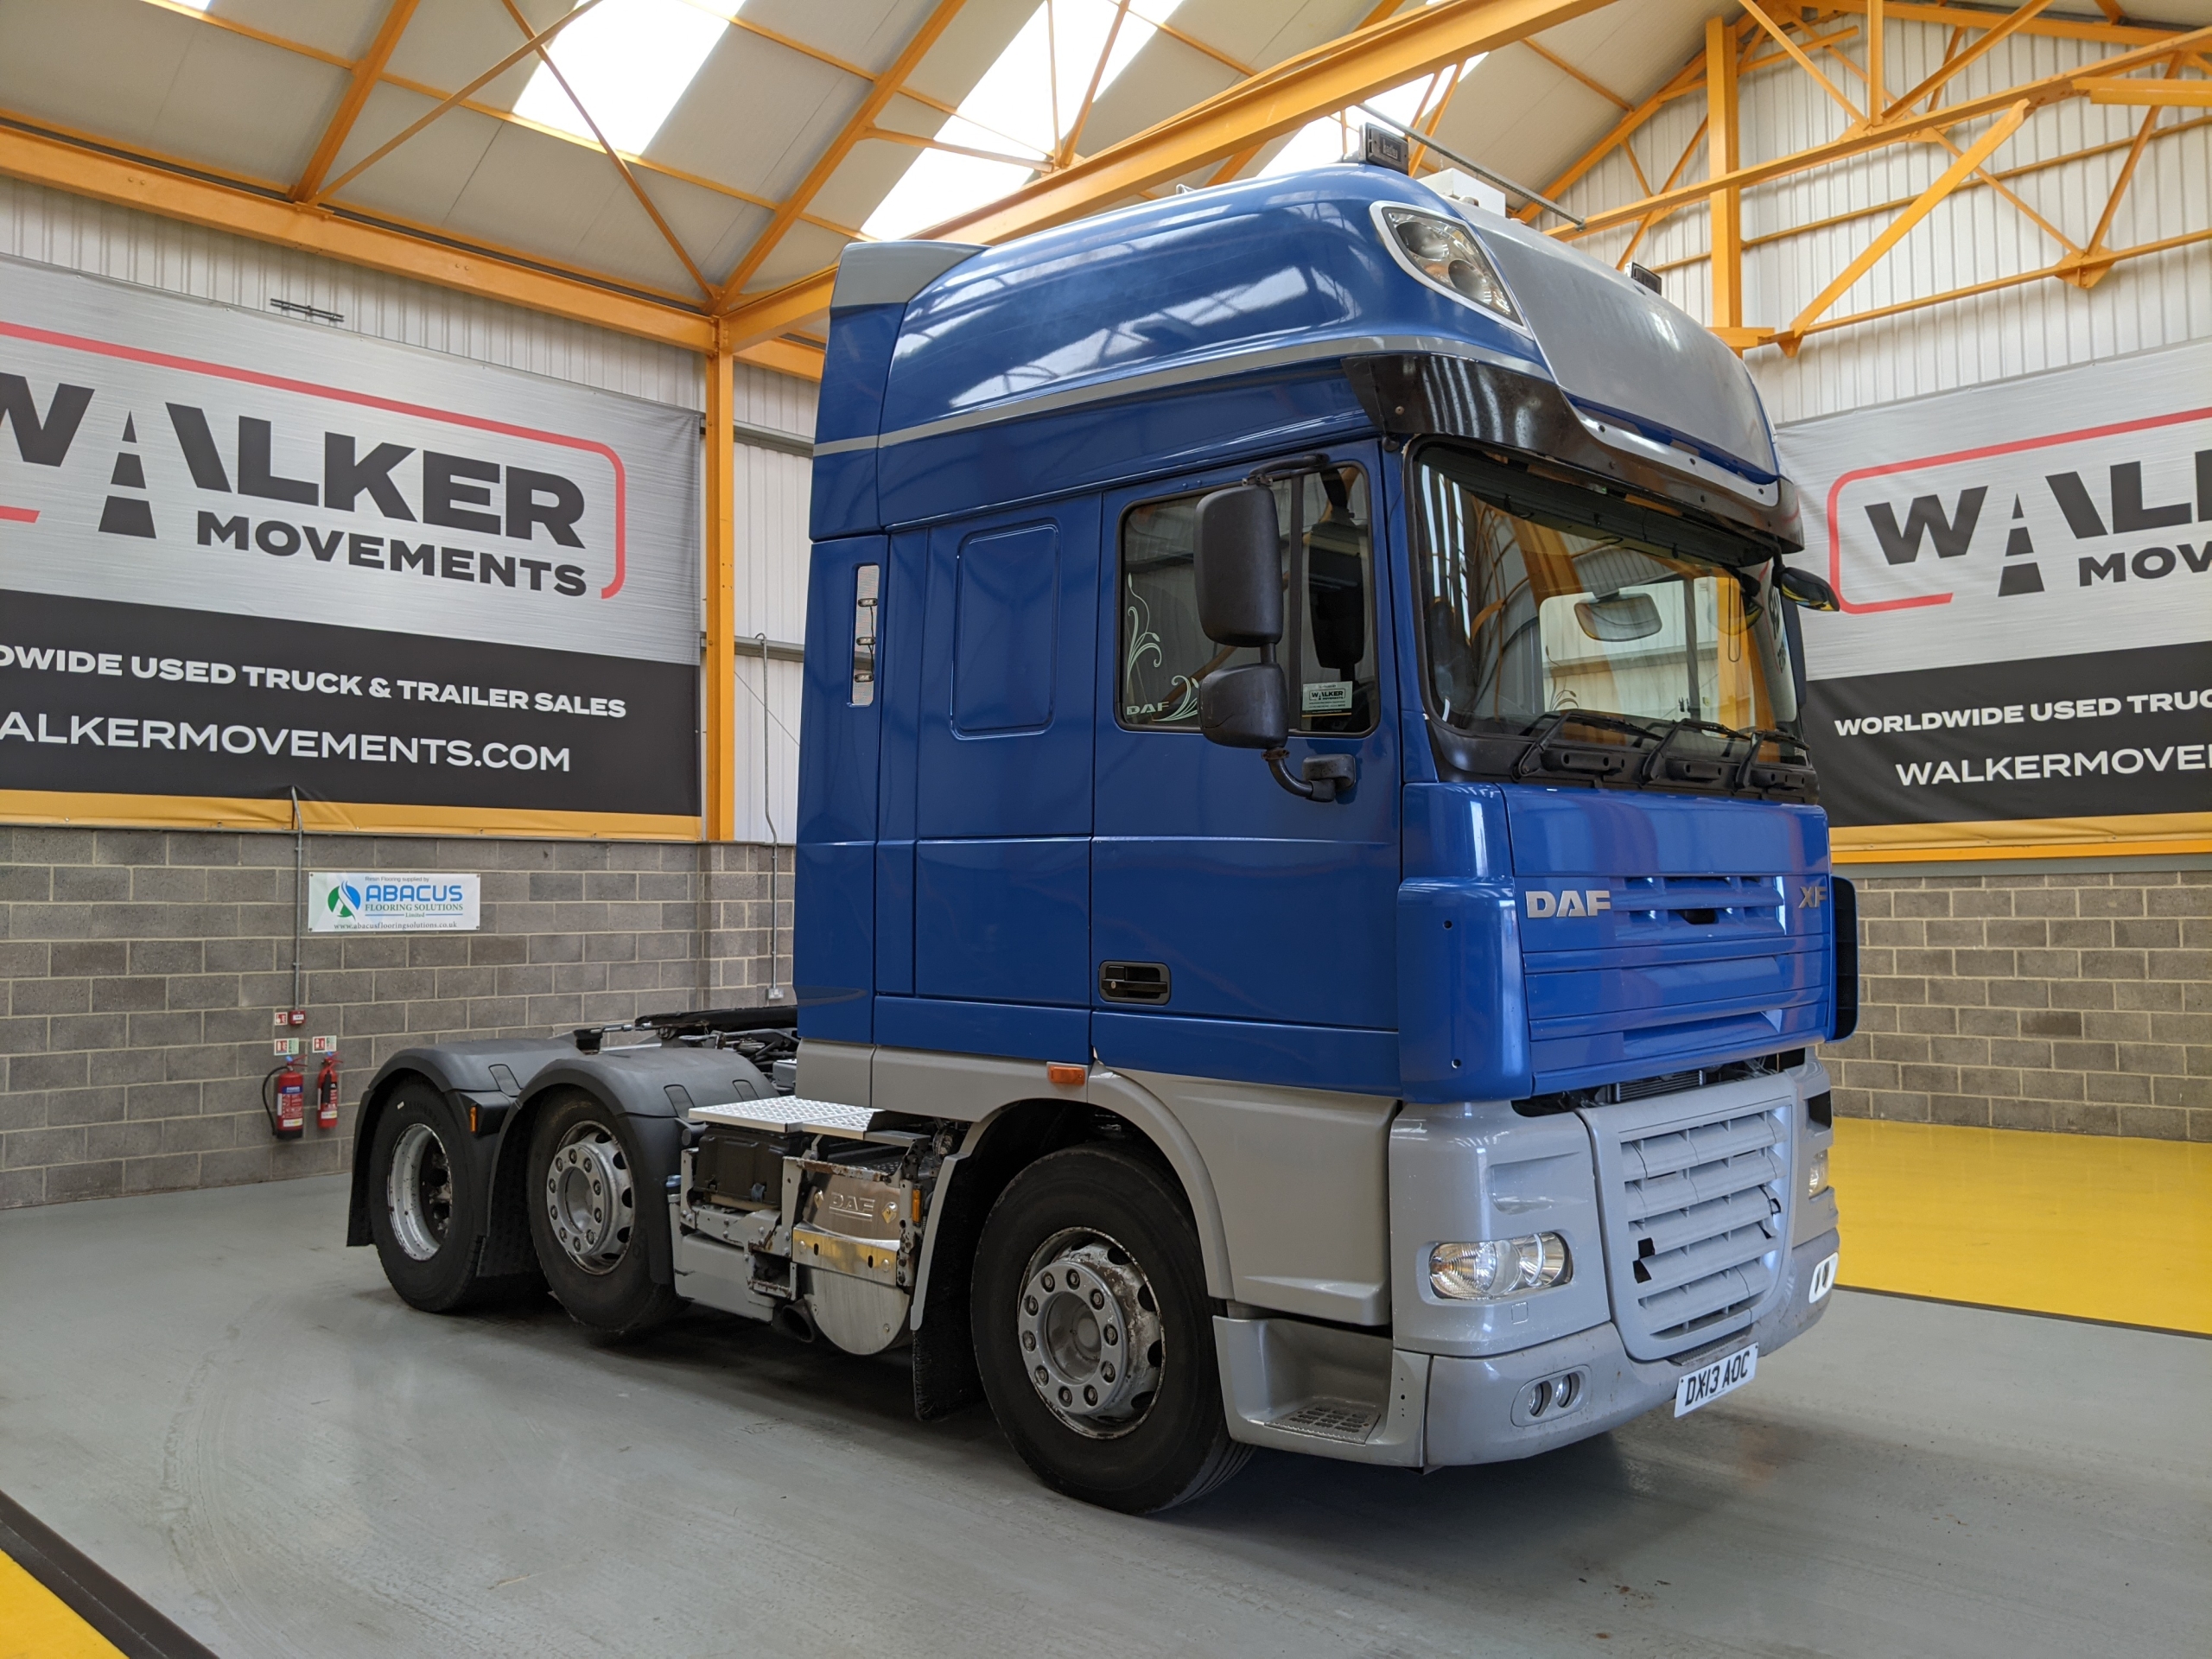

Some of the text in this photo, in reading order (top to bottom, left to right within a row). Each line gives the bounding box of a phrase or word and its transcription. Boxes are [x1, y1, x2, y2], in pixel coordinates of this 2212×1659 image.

[1864, 448, 2212, 597] WAL
[197, 511, 588, 597] MOVEMENTS
[131, 656, 237, 684] USED
[242, 666, 363, 696] TRUCK
[368, 677, 392, 698] &
[397, 679, 530, 710] TRAILER
[534, 692, 626, 718] SALES
[1311, 690, 1344, 701] WALKER
[1126, 702, 1170, 715] DAF
[1834, 704, 2024, 736] WORLDWIDE
[2030, 697, 2122, 721] USED
[1895, 743, 2212, 786] WALKERMOVE
[365, 885, 463, 902] ABACUS
[1525, 889, 1611, 918] DAF
[1798, 886, 1827, 909] XF
[414, 903, 464, 912] SOLUTIONS
[334, 921, 457, 930] www.abacusflooringsolutions.co.uk
[830, 1192, 875, 1212] DAF
[1684, 1350, 1751, 1407] DX13 AOC
